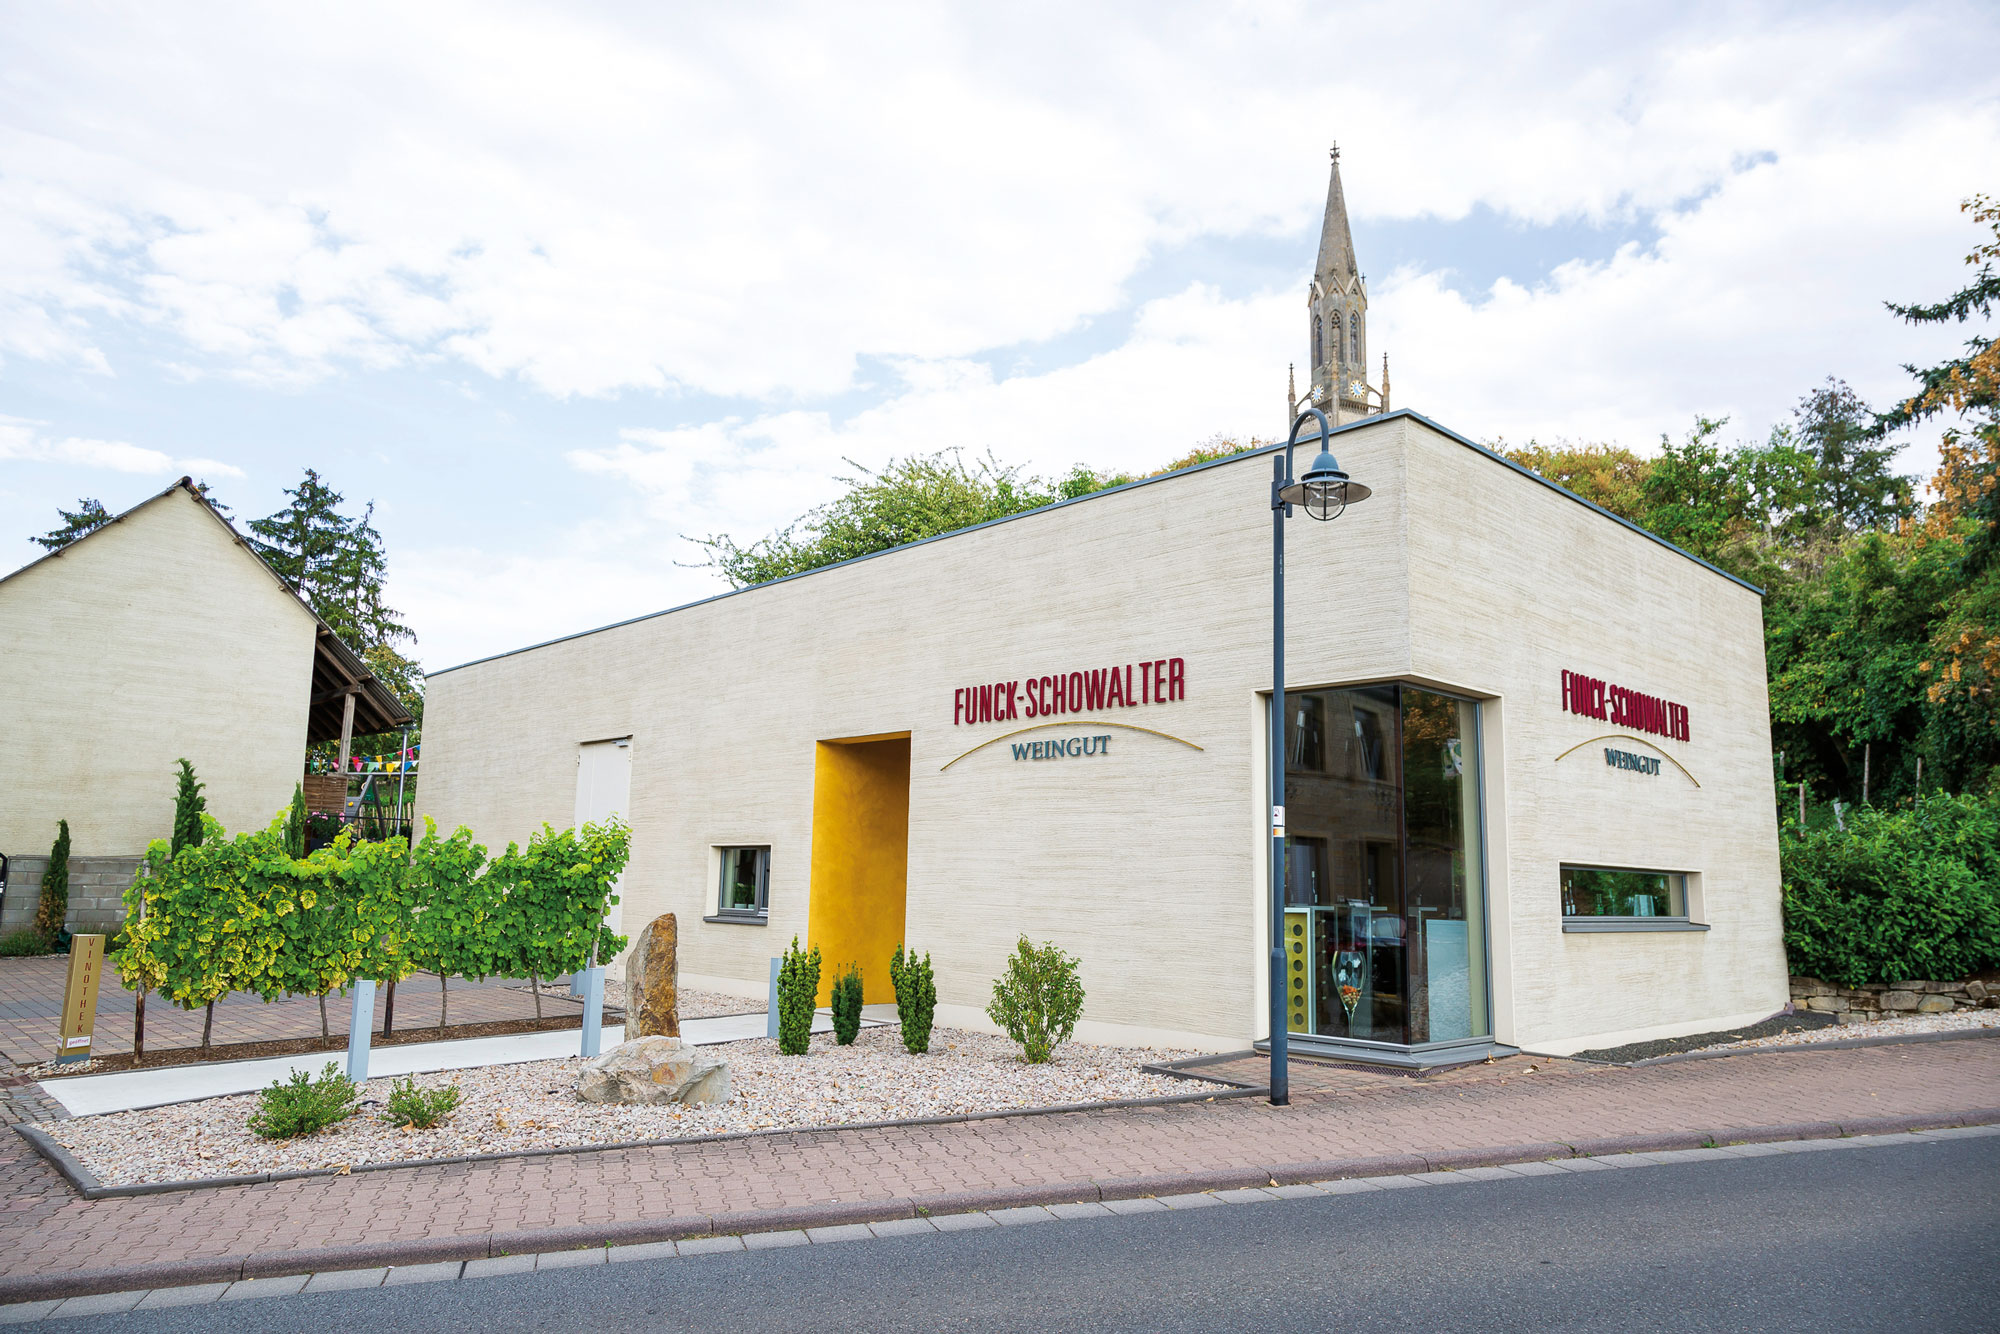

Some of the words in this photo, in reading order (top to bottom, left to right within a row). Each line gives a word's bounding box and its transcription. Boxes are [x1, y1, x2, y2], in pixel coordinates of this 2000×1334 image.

[954, 657, 1184, 725] FUNCK-SCHOWALTER
[1561, 669, 1690, 742] FUNCK-SCHOWALTER
[1011, 735, 1111, 761] WEINGUT
[1604, 748, 1661, 776] WEINGUT
[77, 938, 95, 1033] VINOTHEK
